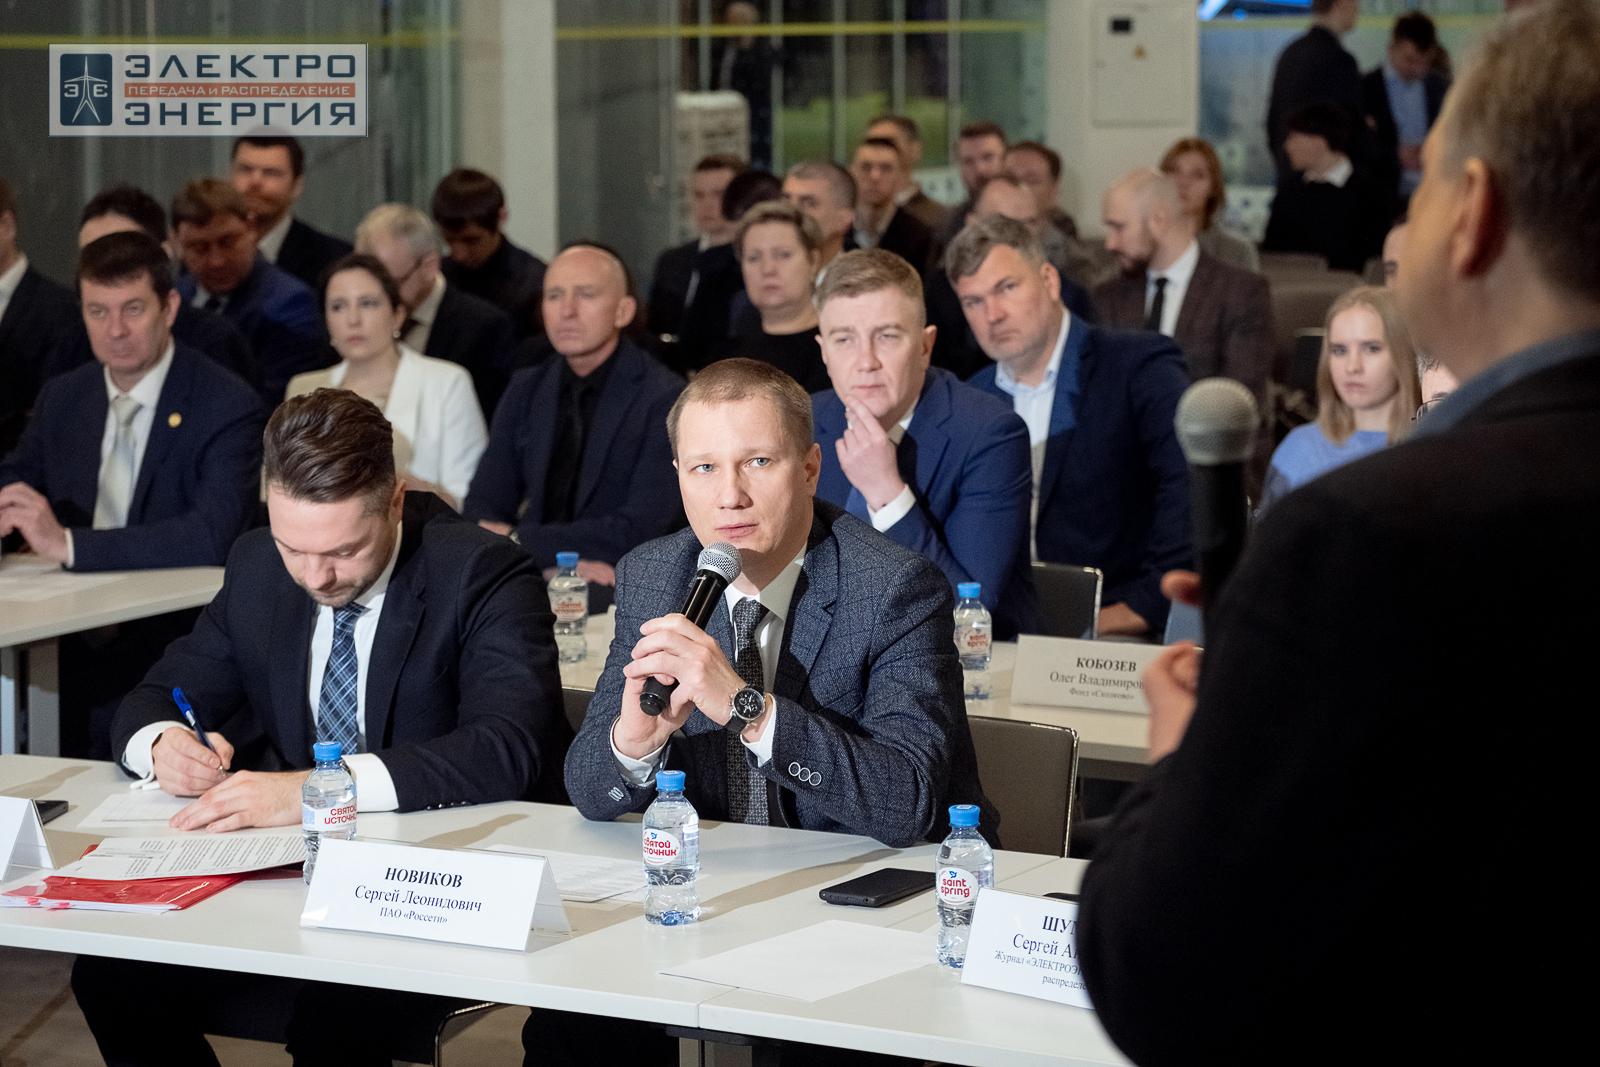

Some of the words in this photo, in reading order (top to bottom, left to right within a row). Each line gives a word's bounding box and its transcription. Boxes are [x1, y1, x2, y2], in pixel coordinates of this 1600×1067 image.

[1076, 657, 1137, 672] КОБОЗЕВ
[1050, 671, 1077, 684] Олег
[643, 846, 677, 857] СТОЧНИК
[384, 867, 463, 888] НОВИКОВ
[942, 878, 967, 887] saint
[355, 884, 400, 903] Сергей
[402, 890, 482, 912] Леонидович
[940, 886, 970, 898] spring
[379, 907, 402, 919] ПАО
[1013, 933, 1058, 955] Сергей
[994, 950, 1024, 963] Журнал
